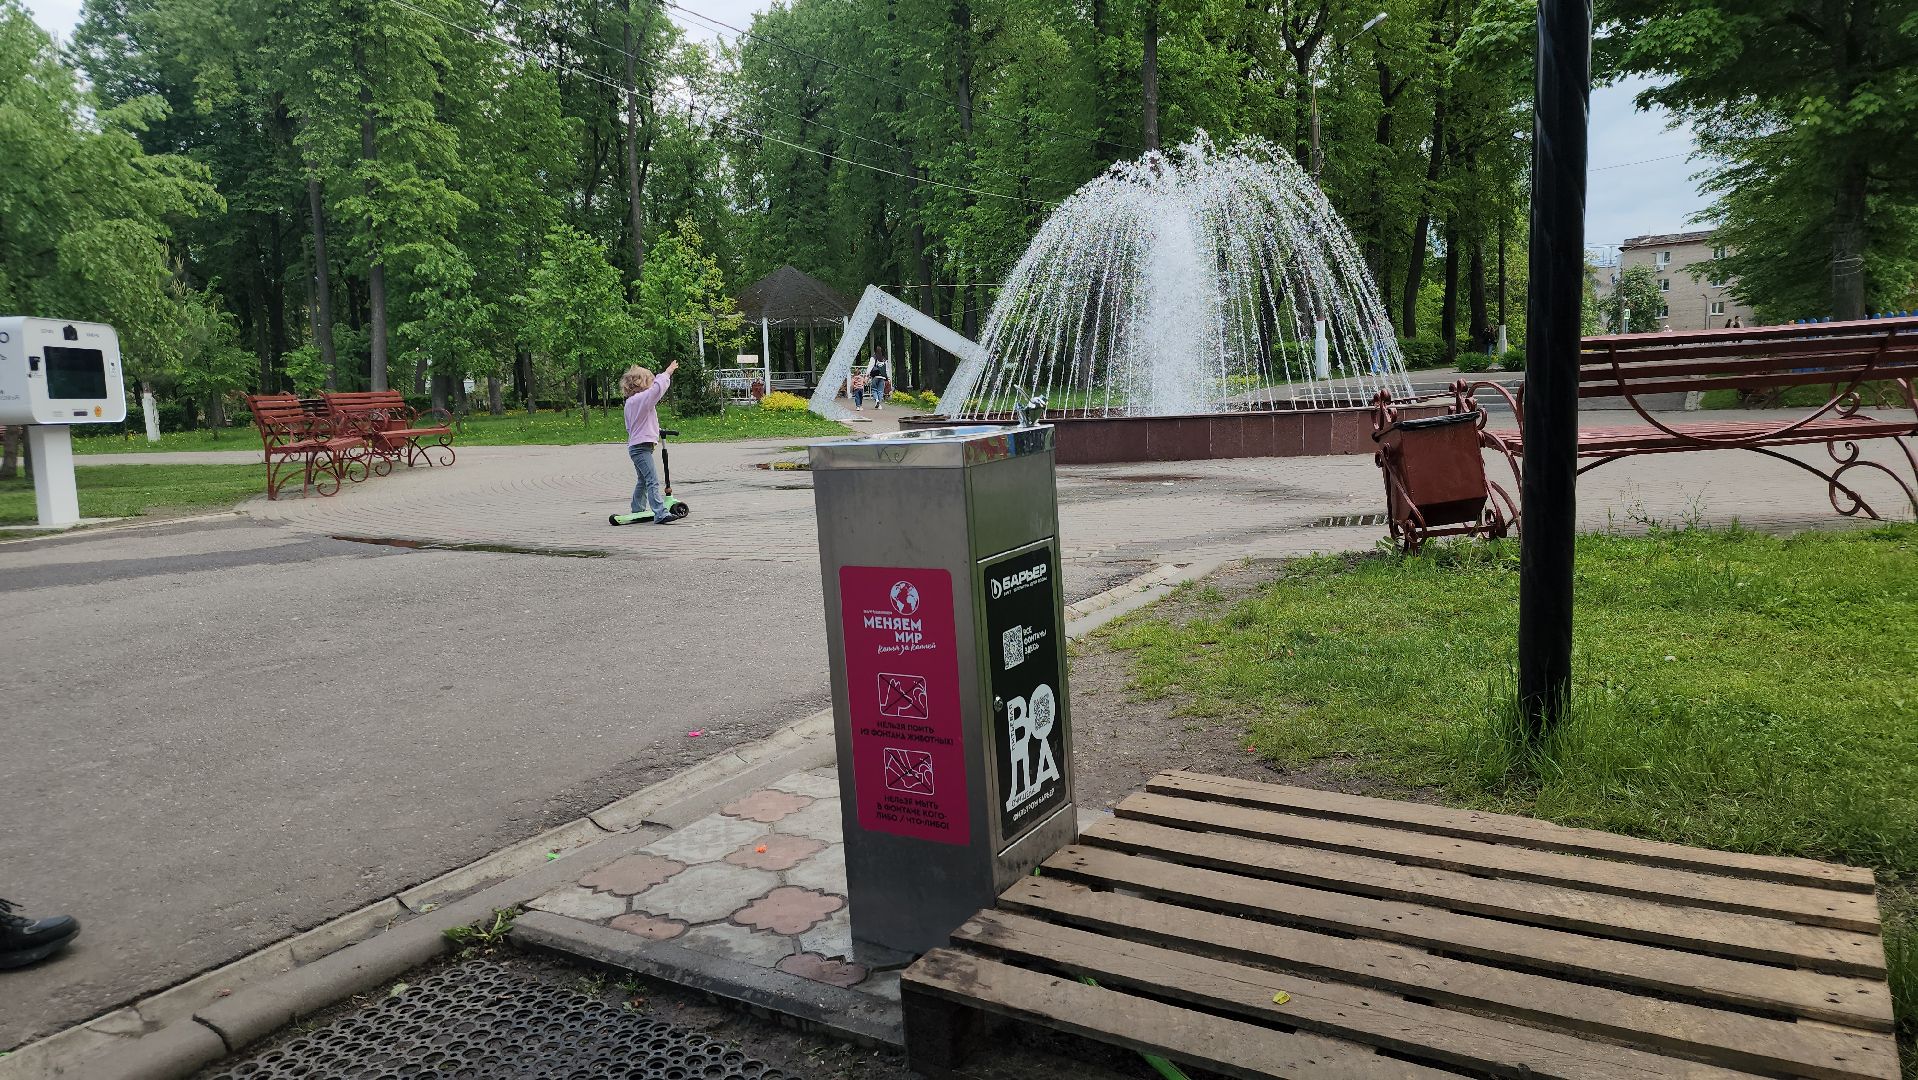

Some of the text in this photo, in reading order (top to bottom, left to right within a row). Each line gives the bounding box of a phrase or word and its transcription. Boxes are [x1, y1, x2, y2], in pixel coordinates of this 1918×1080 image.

[1002, 563, 1047, 591] БАРЬЕР
[863, 615, 922, 631] МЕНЯЕМ
[895, 630, 922, 644] МИР
[876, 721, 934, 734] НЕЛЬЗЯ ПОИТЬ
[870, 729, 906, 740] ФОНТАНА
[884, 804, 922, 816] ФОНТАНЕ
[915, 799, 939, 810] МЫТЬ
[876, 811, 898, 821] ЛИБО
